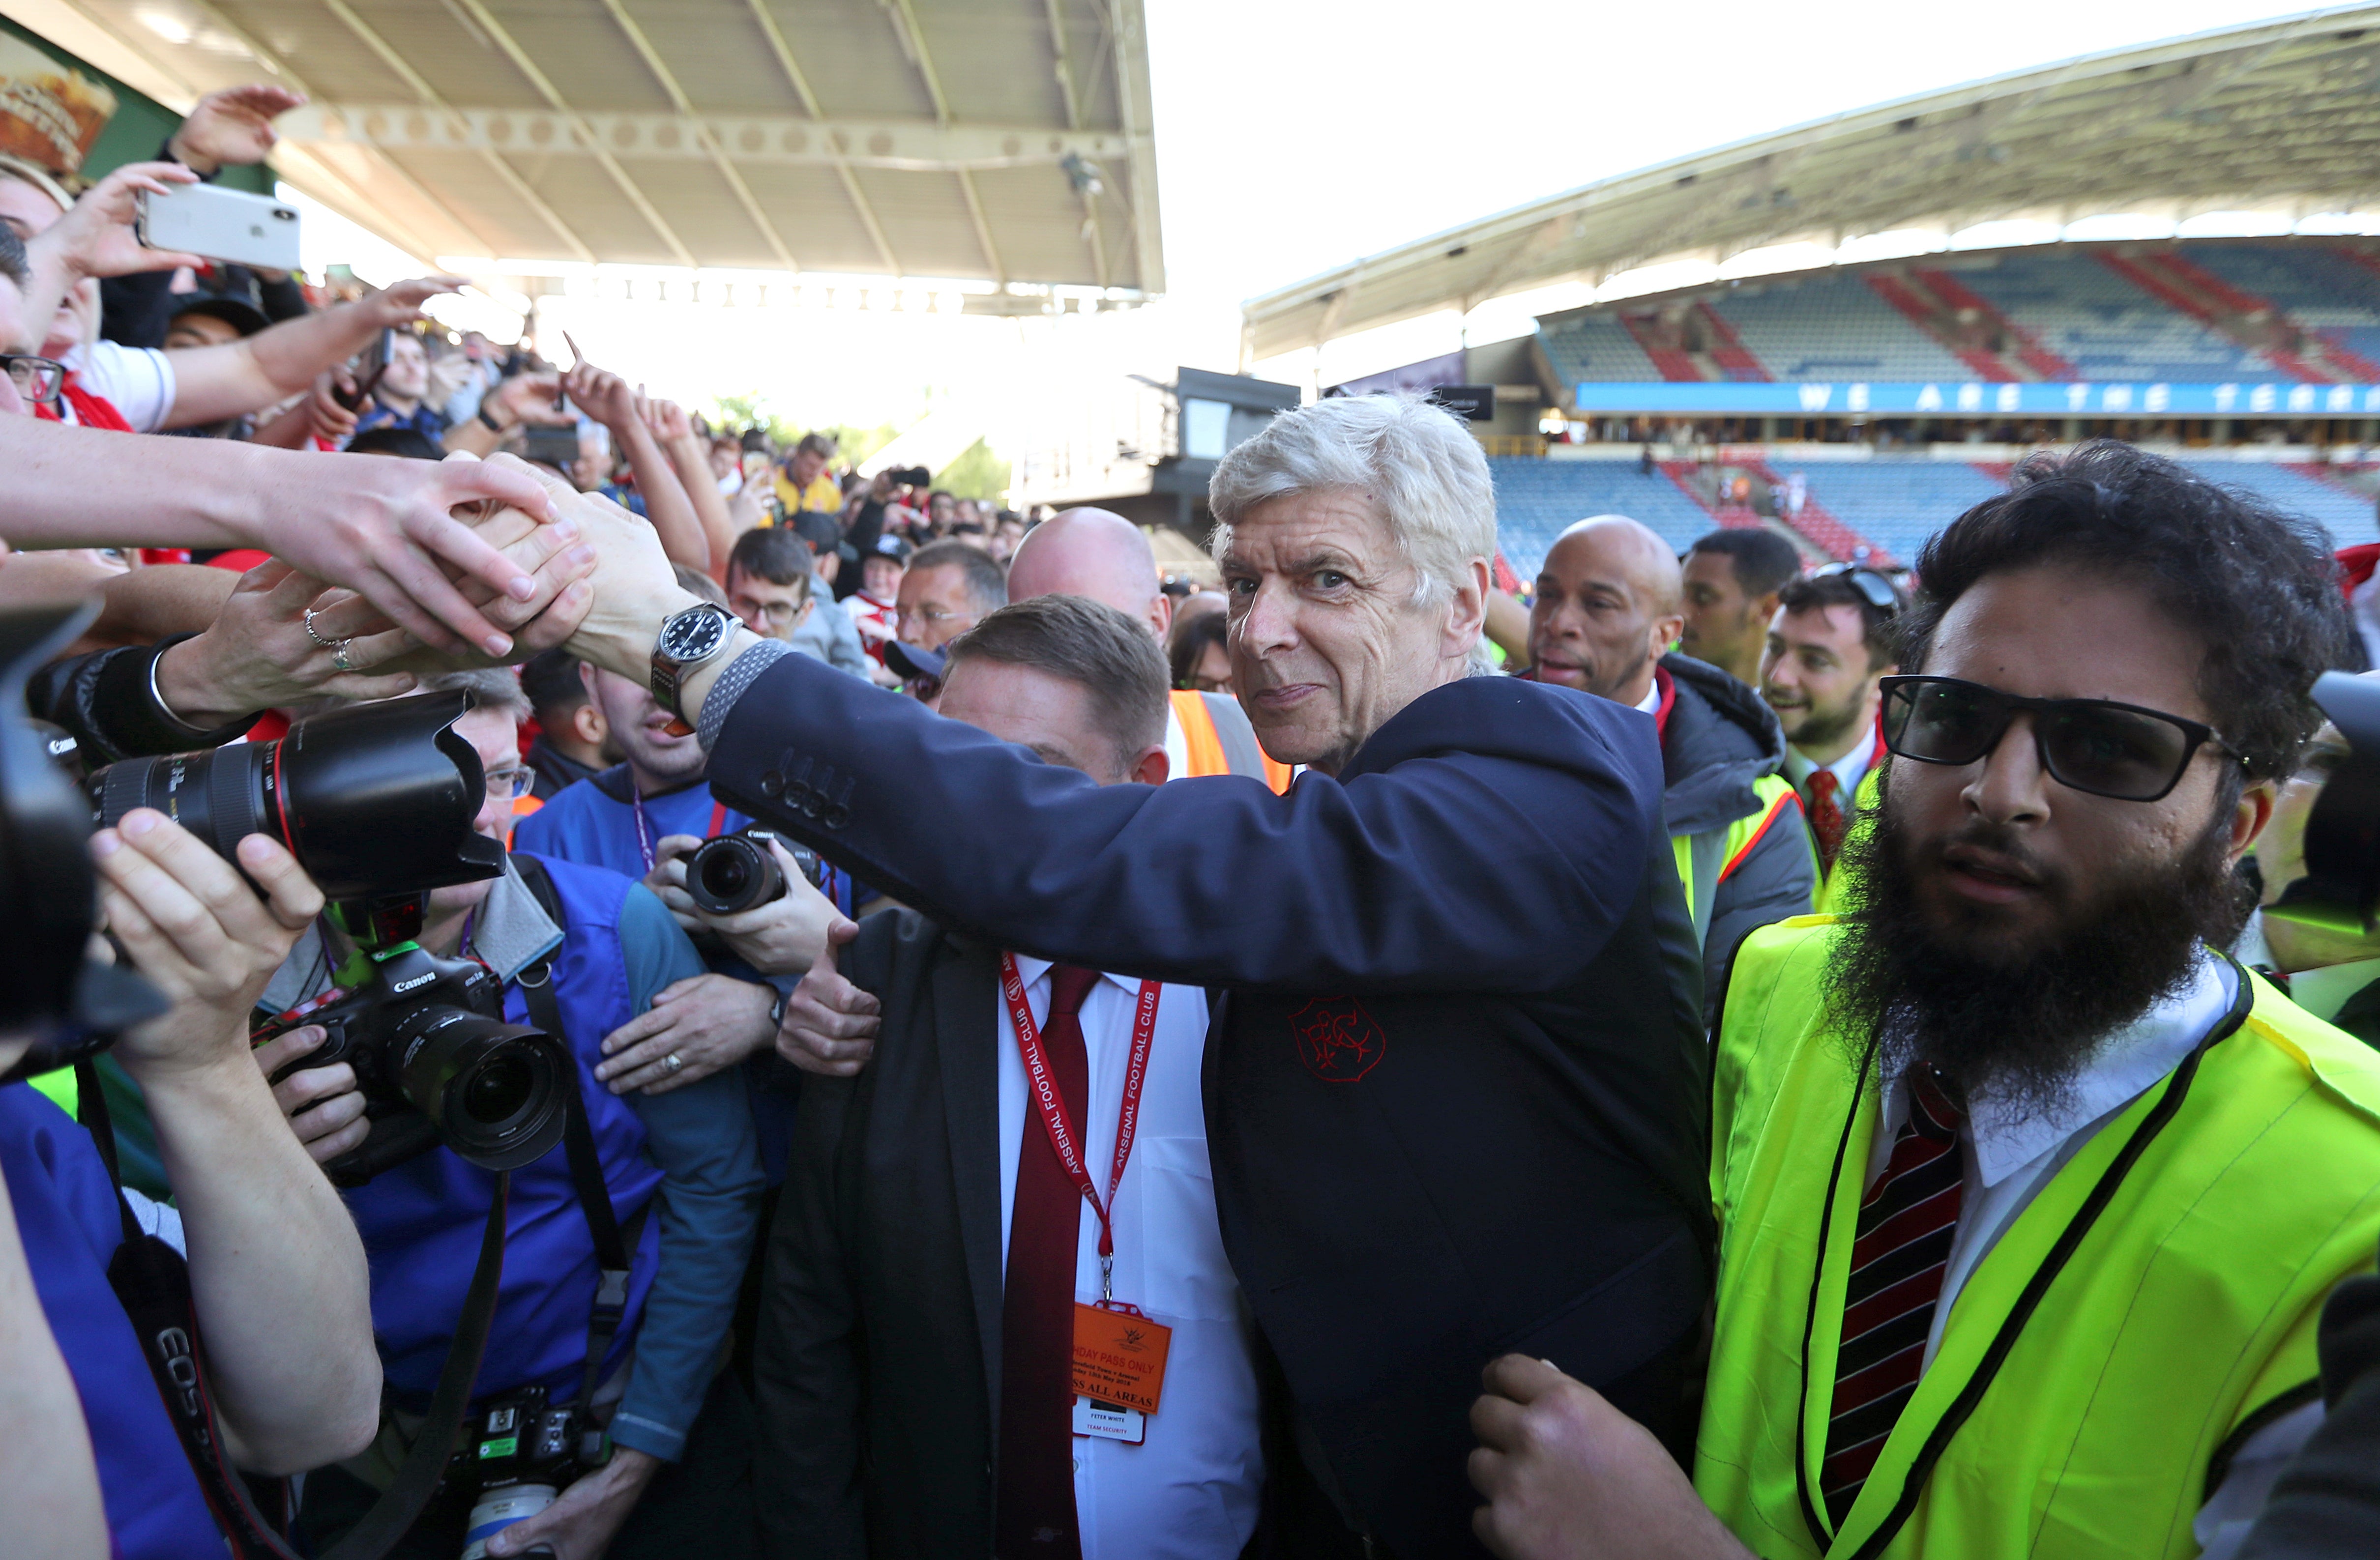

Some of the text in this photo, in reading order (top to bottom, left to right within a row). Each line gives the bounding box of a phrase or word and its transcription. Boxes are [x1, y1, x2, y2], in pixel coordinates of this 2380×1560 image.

[1798, 382, 1870, 412] WE
[1915, 382, 2021, 412] ARE
[2064, 382, 2171, 412] THE
[747, 830, 775, 839] Canon
[394, 971, 437, 993] Canon
[1017, 1008, 1082, 1174] ARSENAL FOOTBALL CLUB
[1117, 991, 1155, 1168] ARSENAL FOOTBALL CLUB
[157, 1328, 198, 1416] EOS
[1100, 1353, 1126, 1368] PASS
[1128, 1359, 1154, 1374] ONLY
[1087, 1384, 1110, 1397] ALL
[1114, 1390, 1153, 1407] AREAS
